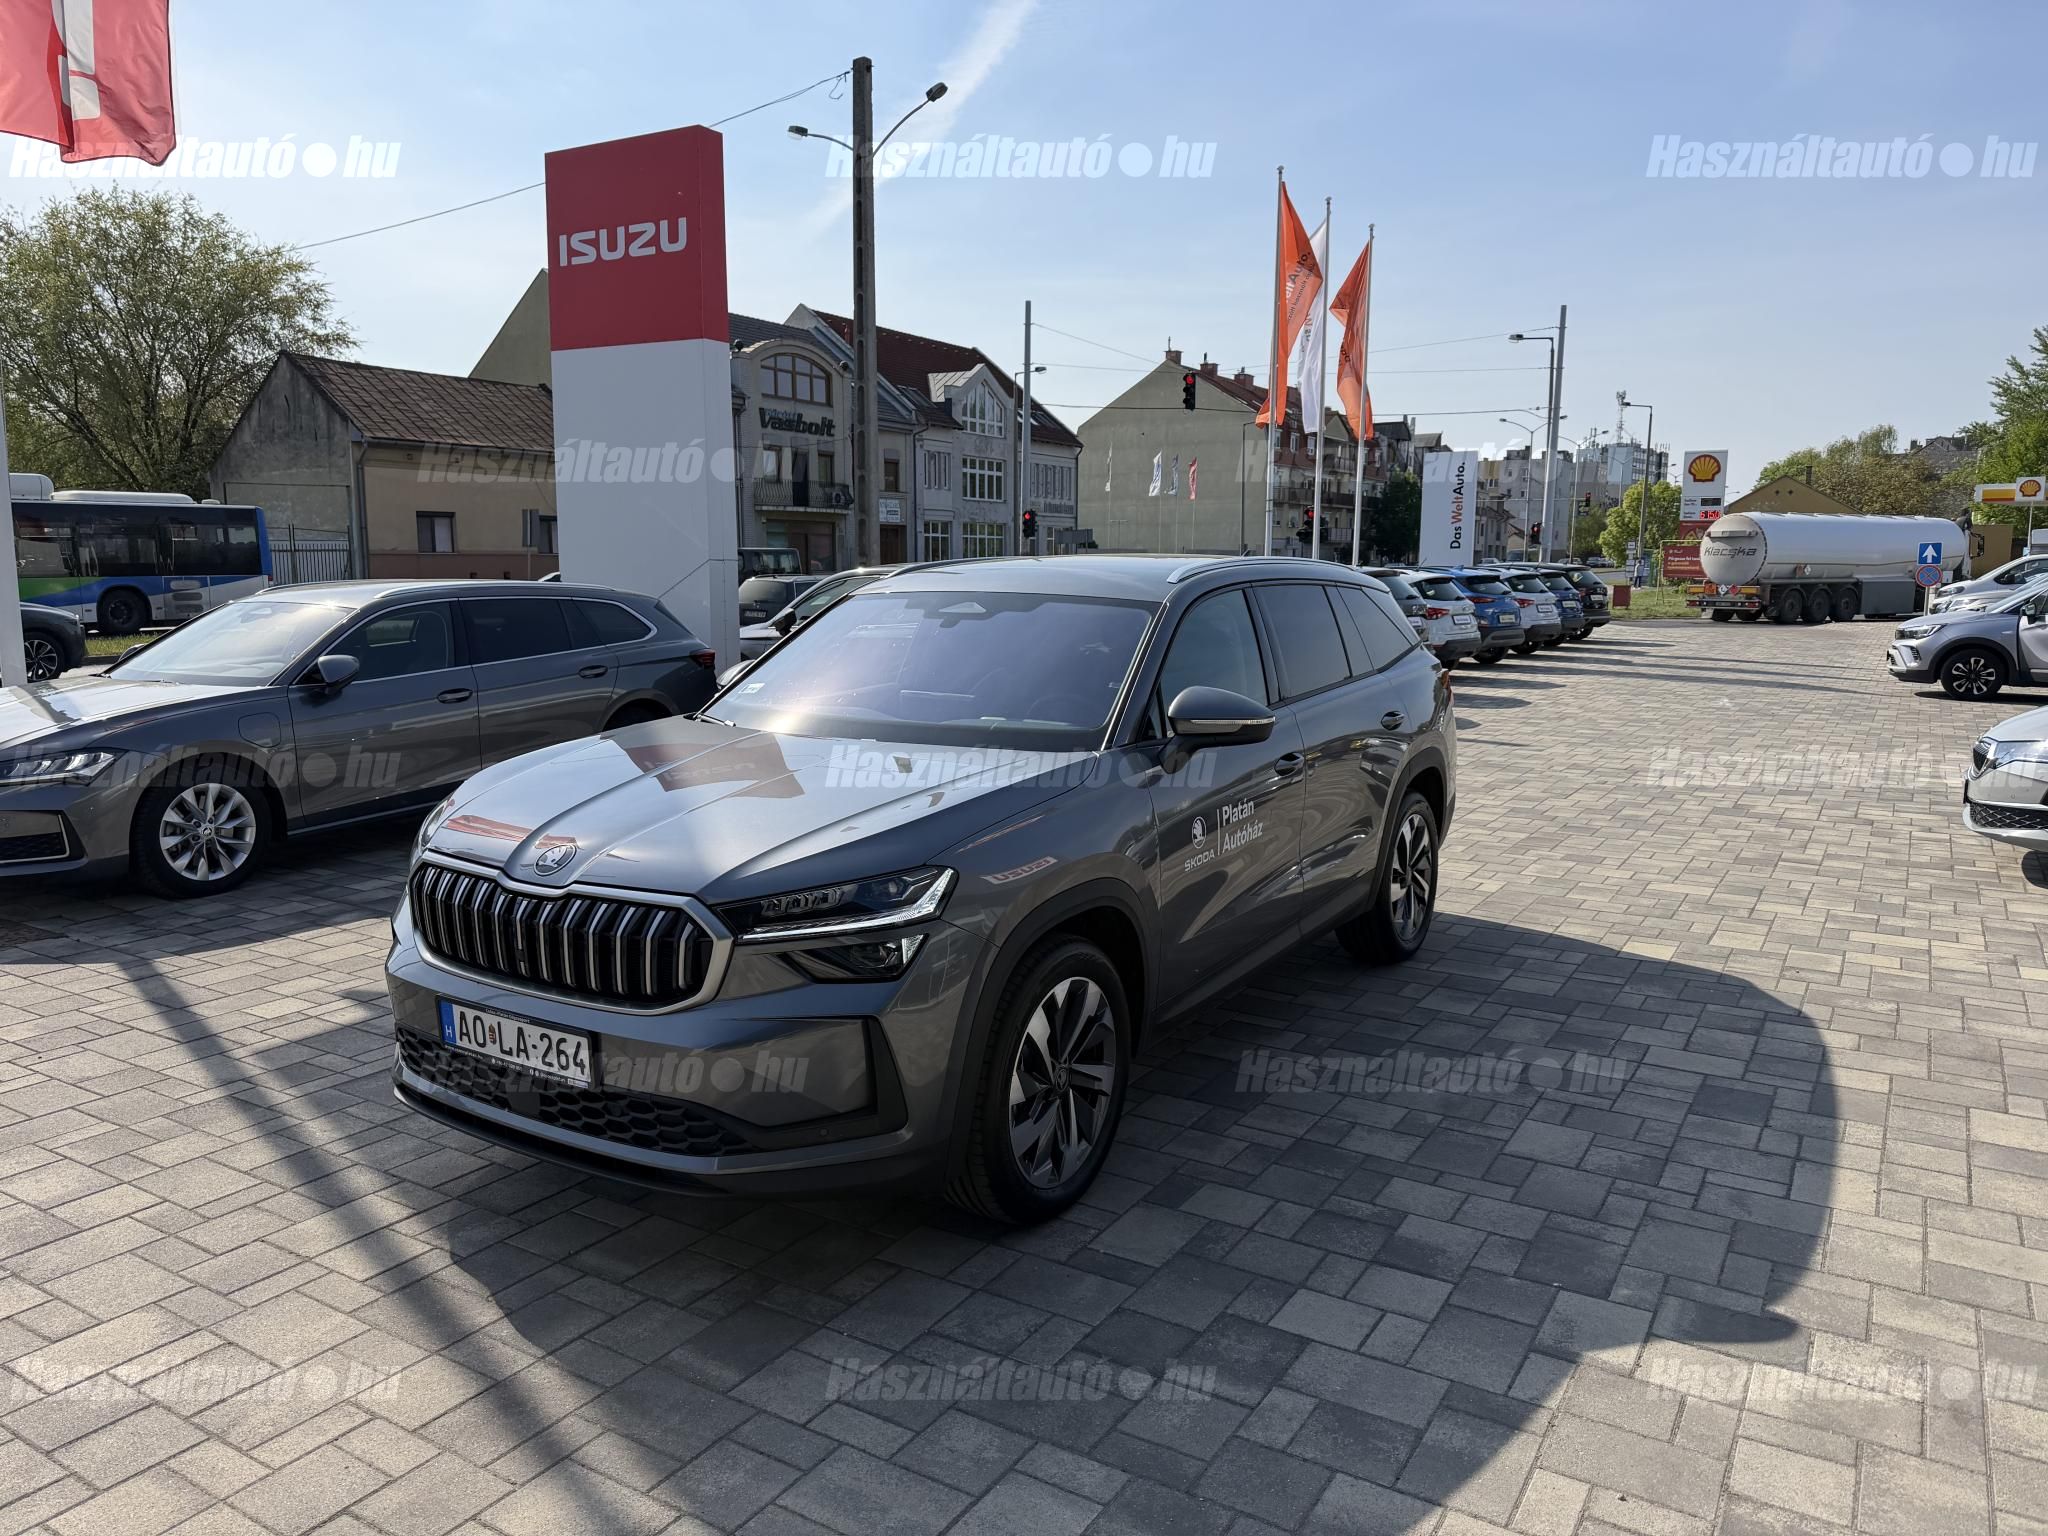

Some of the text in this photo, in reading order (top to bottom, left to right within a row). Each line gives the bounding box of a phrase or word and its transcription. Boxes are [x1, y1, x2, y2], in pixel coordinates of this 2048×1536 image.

[559, 217, 687, 267] ISUZU
[759, 407, 836, 437] Vasbolt
[1450, 462, 1466, 549] Das WeltAuto.
[1222, 798, 1255, 826] Platán
[1222, 820, 1264, 853] Autóház
[445, 1025, 453, 1038] H
